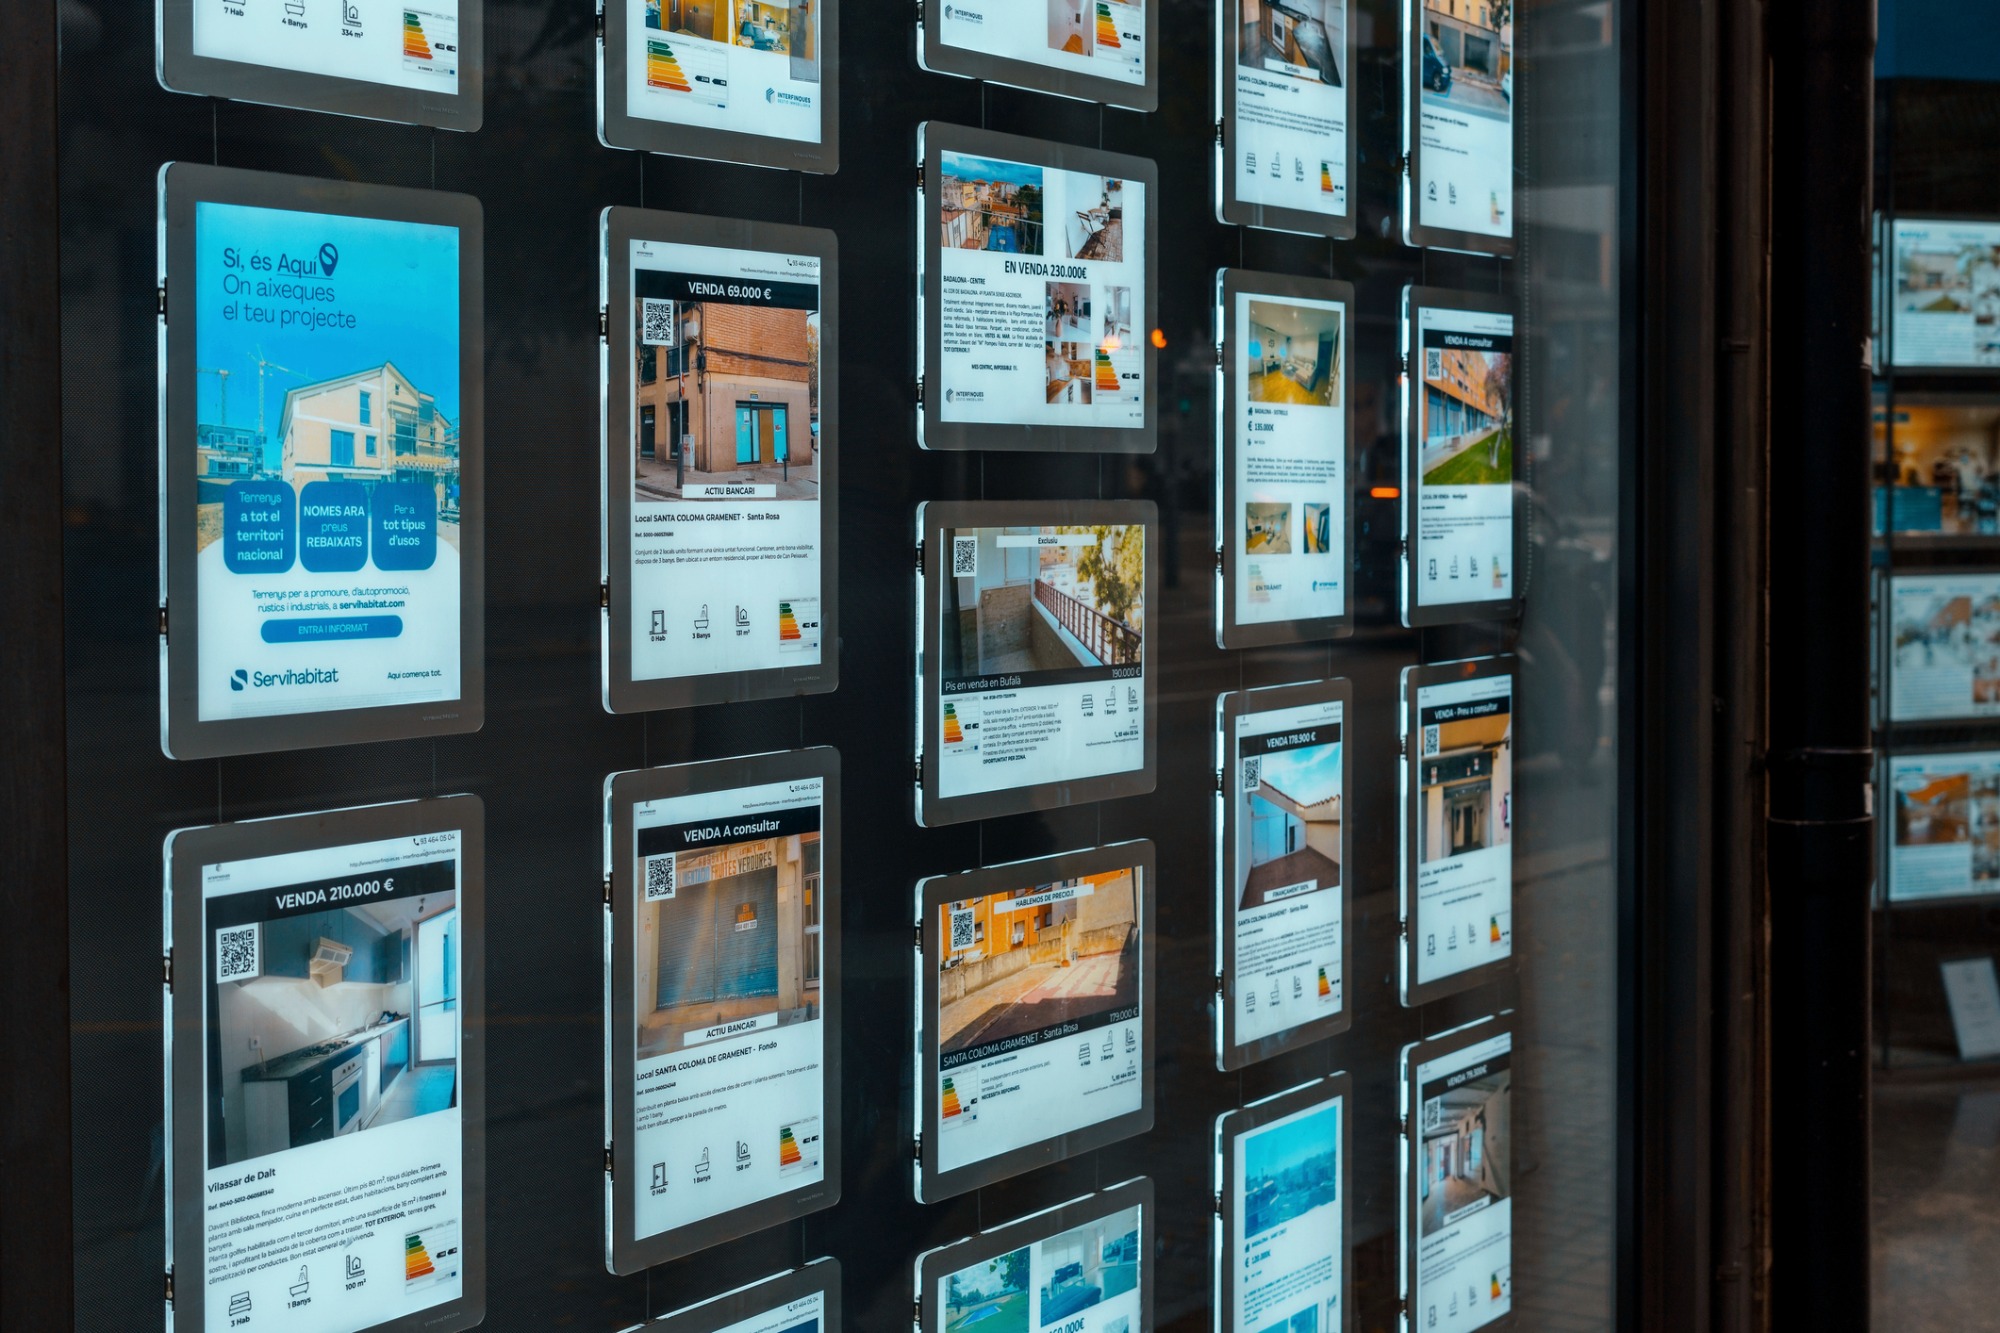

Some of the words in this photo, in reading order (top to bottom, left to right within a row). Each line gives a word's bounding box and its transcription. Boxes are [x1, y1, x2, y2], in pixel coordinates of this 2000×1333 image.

[224, 7, 229, 15] 7
[231, 8, 244, 17] Hab
[955, 9, 983, 21] INTERFINQUES
[282, 18, 286, 26] 4
[289, 19, 308, 29] Banys
[342, 28, 353, 37] 334
[354, 31, 364, 39] m²
[778, 92, 811, 103] INTERFINQUES
[223, 248, 245, 270] Sí,
[250, 249, 272, 272] és
[277, 253, 317, 279] Aquí
[1005, 261, 1016, 274] EN
[1018, 262, 1049, 276] VENDA
[1050, 265, 1087, 279] 230.000€
[223, 274, 250, 295] On
[256, 278, 335, 307] aixeques
[688, 282, 725, 296] VENDA
[728, 285, 761, 299] 69.000
[764, 288, 772, 300] €
[223, 301, 238, 321] el
[244, 304, 275, 323] teu
[280, 307, 357, 331] projecte
[726, 487, 755, 495] BANCARI
[239, 492, 281, 506] Terrenys
[304, 506, 342, 517] NOMES
[343, 506, 365, 517] ARA
[395, 505, 407, 514] Per
[241, 513, 248, 522] a
[251, 511, 268, 522] tot
[271, 510, 280, 521] el
[635, 515, 652, 523] Local
[654, 514, 675, 522] SANTA
[677, 514, 705, 522] COLOMA
[706, 513, 741, 522] GRAMENET
[747, 513, 764, 521] Santa
[322, 523, 348, 534] preus
[383, 520, 399, 530] tot
[401, 520, 426, 532] tipus
[237, 530, 284, 541] territori
[307, 537, 362, 548] REBAIXATS
[238, 549, 283, 561] nacional
[252, 589, 286, 602] Terrenys
[289, 590, 302, 599] per
[304, 590, 309, 598] a
[311, 589, 350, 599] promoure,
[258, 600, 285, 612] rústics
[287, 602, 289, 611] i
[291, 601, 331, 612] industrials,
[340, 599, 405, 609] servihabitat.com
[299, 626, 324, 635] ENTRA
[697, 632, 711, 640] Banys
[254, 668, 339, 687] Servihabitat
[388, 671, 400, 680] Aquí
[402, 670, 429, 680] comença
[1112, 669, 1135, 678] 190.000
[1136, 668, 1141, 676] €
[946, 682, 956, 691] Pis
[967, 679, 988, 689] venda
[1000, 677, 1021, 687] Bufalà
[684, 827, 721, 842] VENDA
[723, 825, 731, 837] A
[733, 820, 780, 835] consultar
[428, 836, 439, 844] 464
[448, 834, 455, 842] 04
[276, 889, 326, 910] VENDA
[330, 880, 380, 901] 210.000
[384, 878, 394, 892] €
[1016, 896, 1043, 908] HABLEMOS
[1045, 894, 1051, 902] DE
[1133, 1007, 1138, 1017] €
[706, 1028, 726, 1038] ACTIU
[728, 1020, 757, 1034] BANCARI
[944, 1052, 967, 1067] SANTA
[968, 1045, 1000, 1060] COLOMA
[1000, 1035, 1039, 1050] GRAMENET
[1044, 1028, 1062, 1039] Santa
[1064, 1023, 1078, 1034] Rosa
[637, 1070, 654, 1081] Local
[655, 1064, 677, 1077] SANTA
[678, 1057, 707, 1072] COLOMA
[708, 1055, 717, 1064] DE
[718, 1047, 753, 1062] GRAMENET
[759, 1041, 778, 1052] Fondo
[208, 1178, 242, 1193] Vilassar
[244, 1174, 256, 1184] de
[257, 1168, 276, 1181] Dalt
[697, 1174, 711, 1184] Banys
[208, 1221, 229, 1232] Davant
[231, 1212, 260, 1226] Biblioteca,
[262, 1207, 276, 1217] finca
[277, 1201, 305, 1214] moderna
[304, 1196, 317, 1207] amb
[318, 1191, 341, 1202] ascensor.
[360, 1182, 368, 1192] pis
[387, 1173, 400, 1185] tipus
[421, 1163, 441, 1173] Primera
[657, 1187, 667, 1196] Hab
[209, 1241, 233, 1253] banyera.
[345, 1283, 356, 1291] 100
[292, 1297, 312, 1308] Banys
[237, 1316, 250, 1326] Hab
